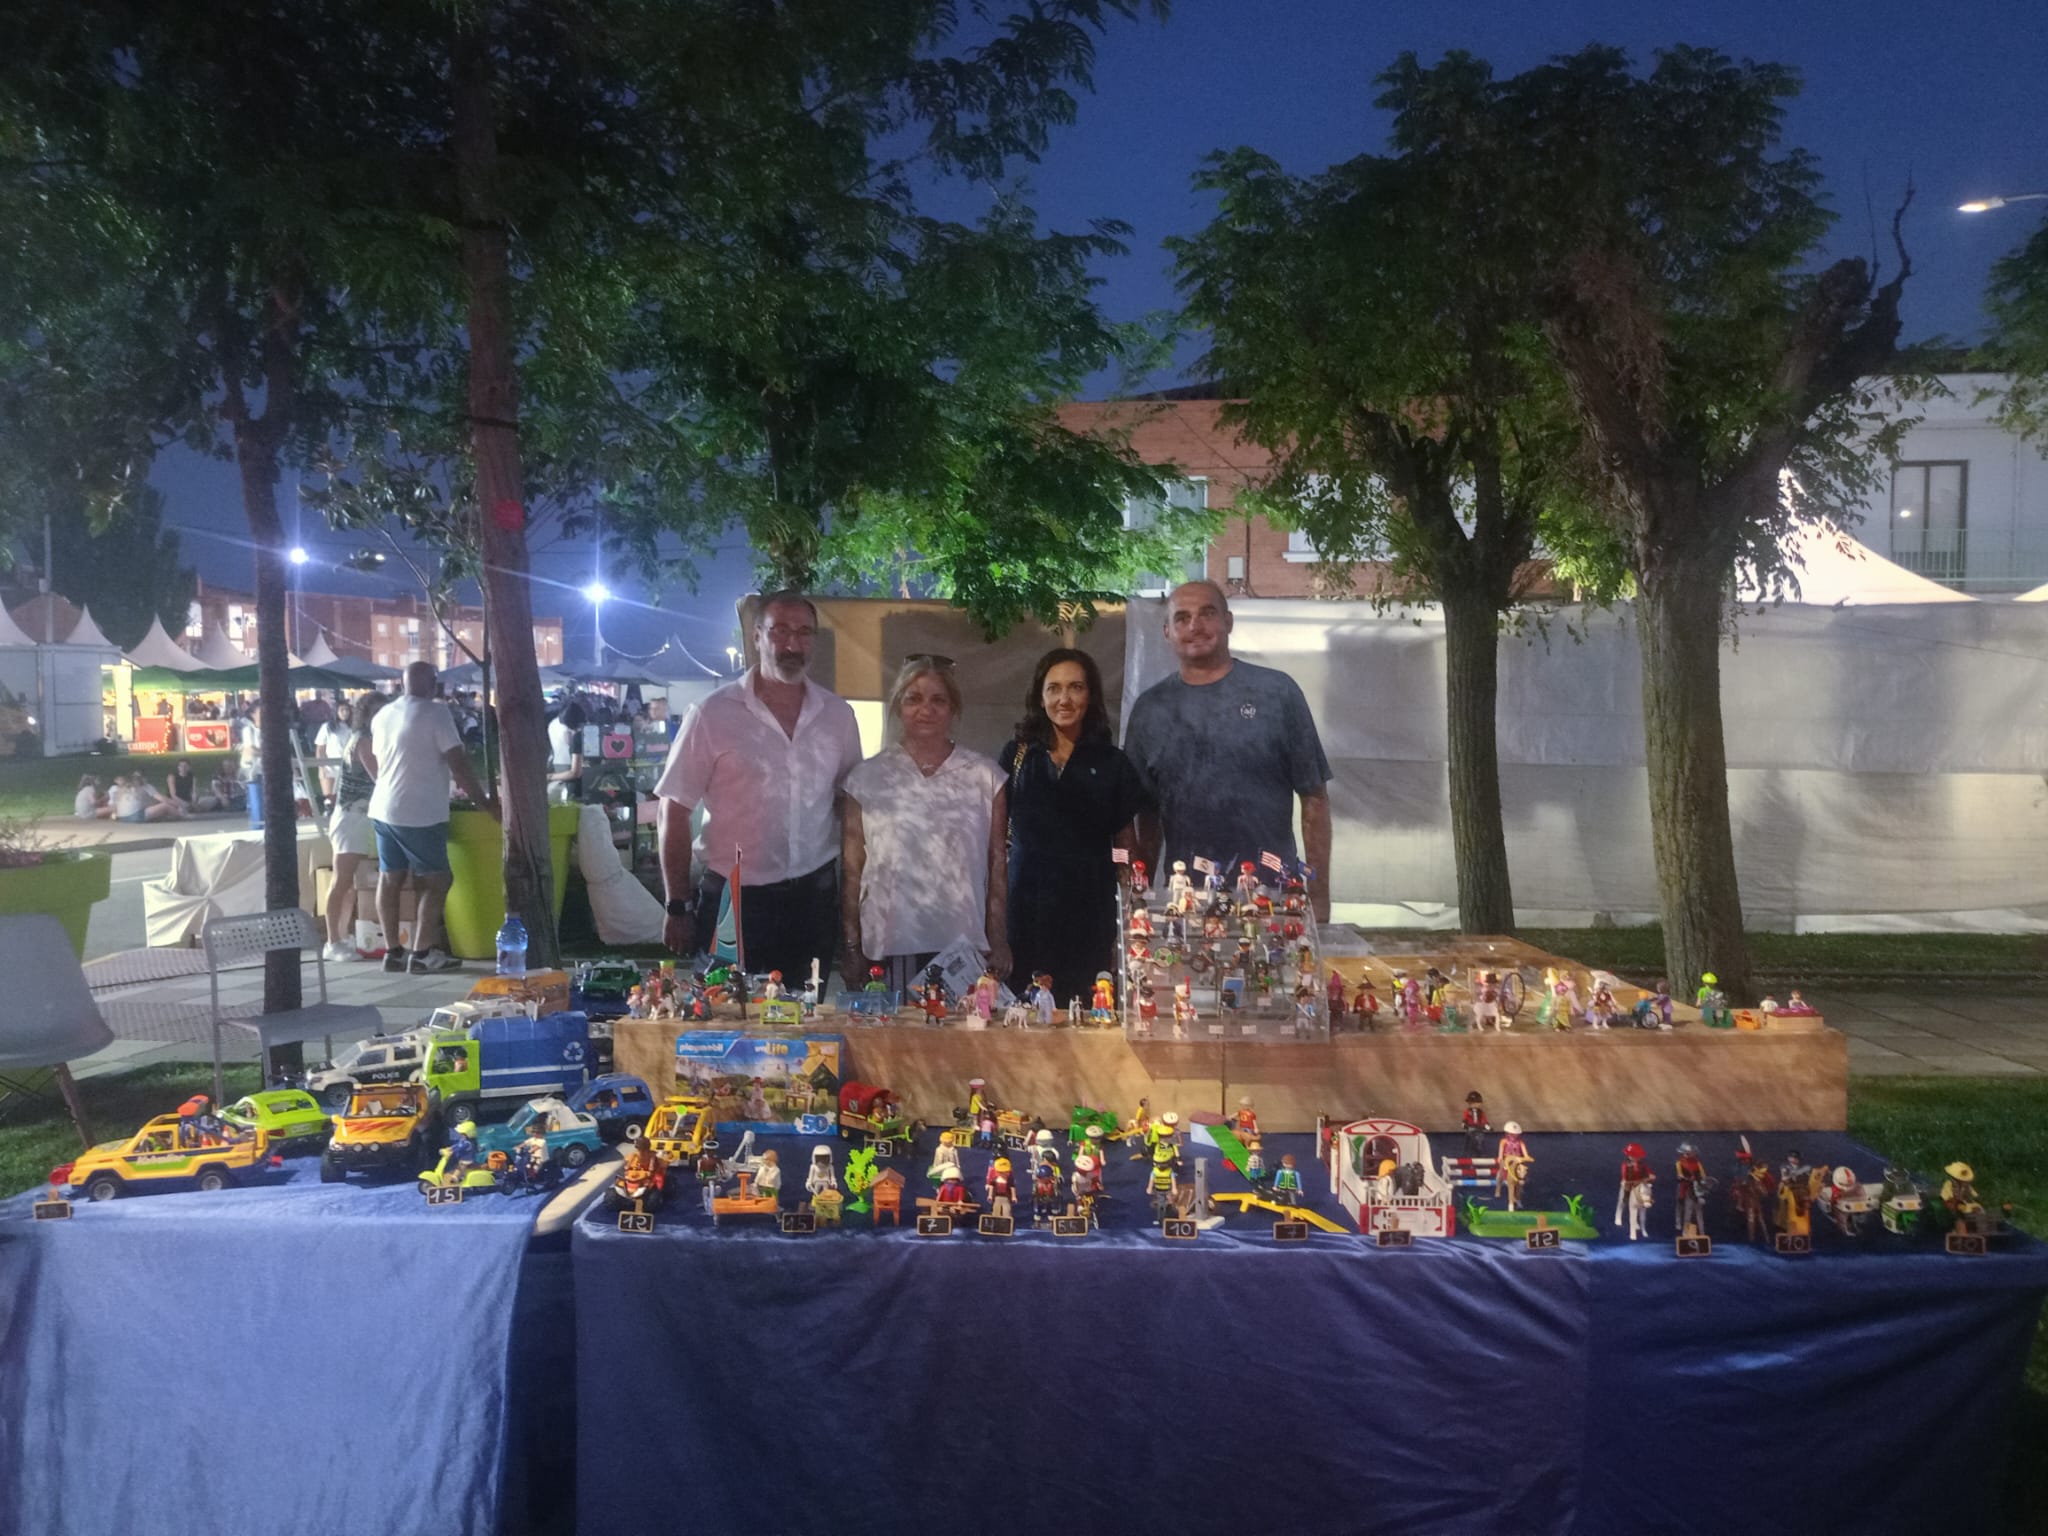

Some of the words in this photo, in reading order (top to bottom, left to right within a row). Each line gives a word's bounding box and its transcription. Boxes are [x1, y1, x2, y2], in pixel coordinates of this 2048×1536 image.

[680, 1043, 723, 1053] playmobil
[801, 1113, 829, 1134] 50
[1007, 1137, 1023, 1150] 15
[430, 1187, 455, 1203] 15
[926, 1219, 938, 1232] 7
[1169, 1223, 1191, 1236] 10
[1782, 1237, 1804, 1250] 10
